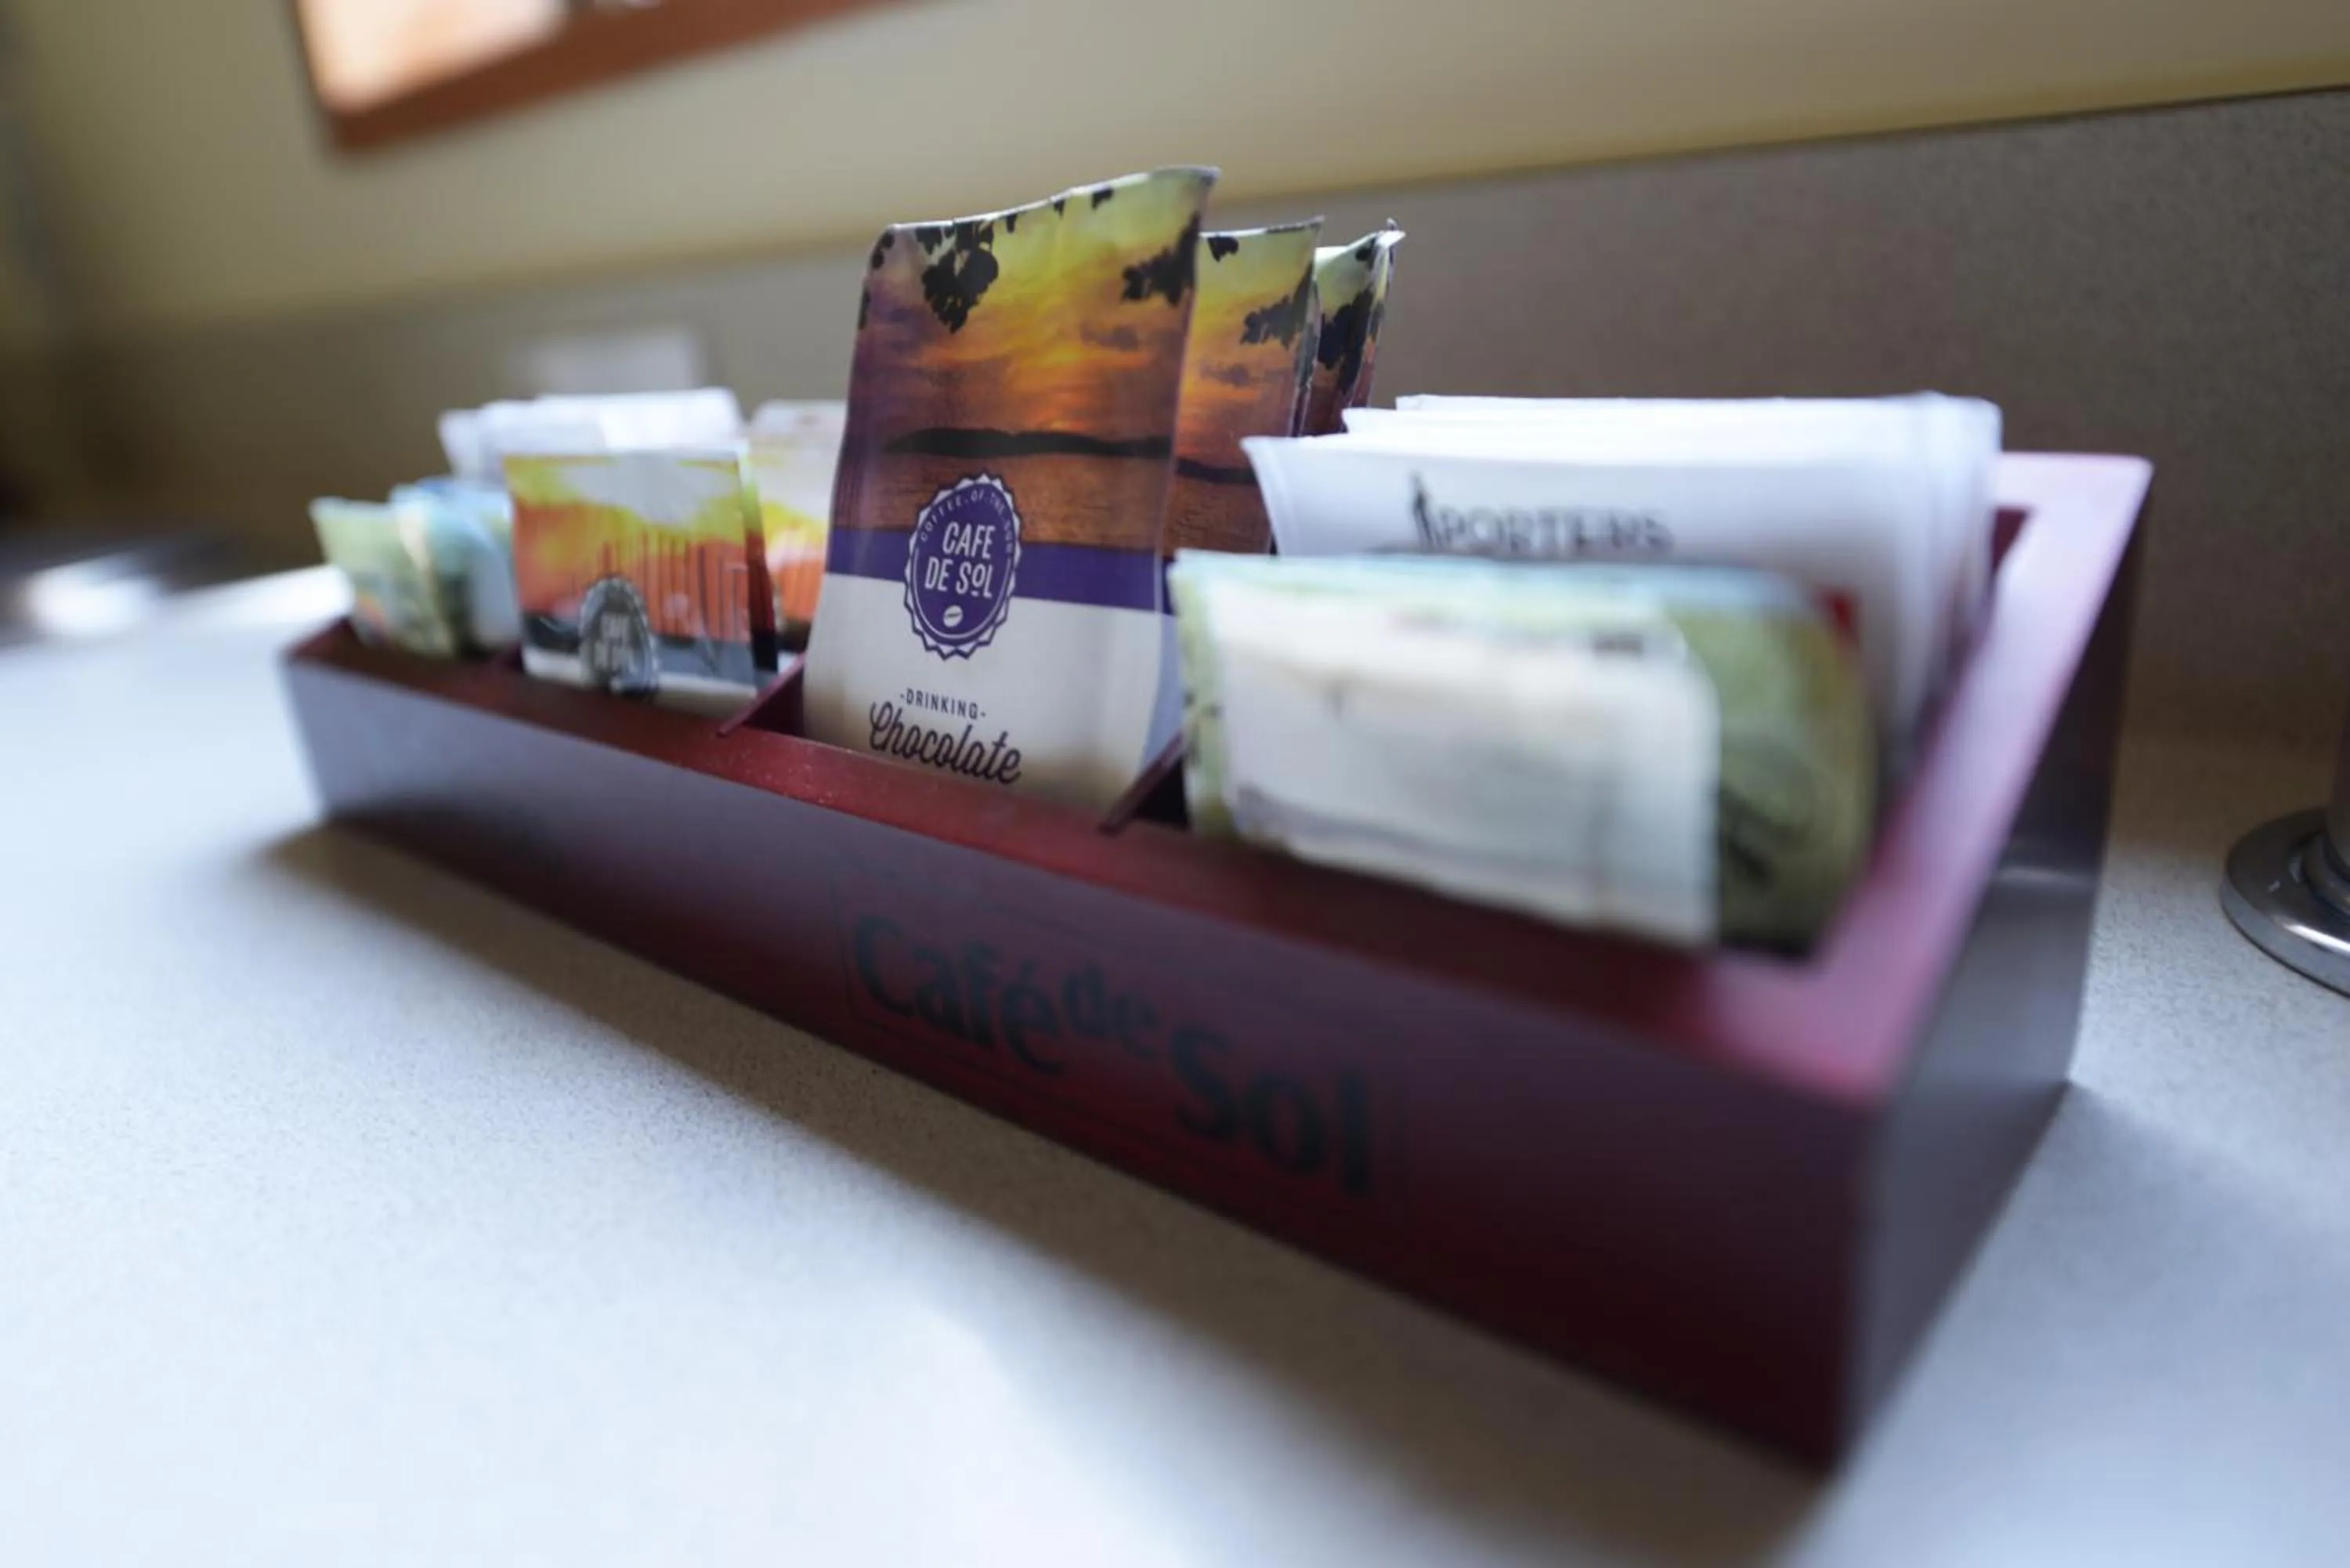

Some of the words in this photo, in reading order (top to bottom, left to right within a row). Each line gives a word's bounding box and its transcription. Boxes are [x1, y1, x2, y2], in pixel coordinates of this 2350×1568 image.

[942, 520, 996, 559] CAFE
[924, 556, 953, 592] DE
[869, 701, 1022, 784] Chocolate
[851, 913, 1065, 1077] Café
[1061, 961, 1159, 1061] de
[1169, 1020, 1376, 1198] Sol
